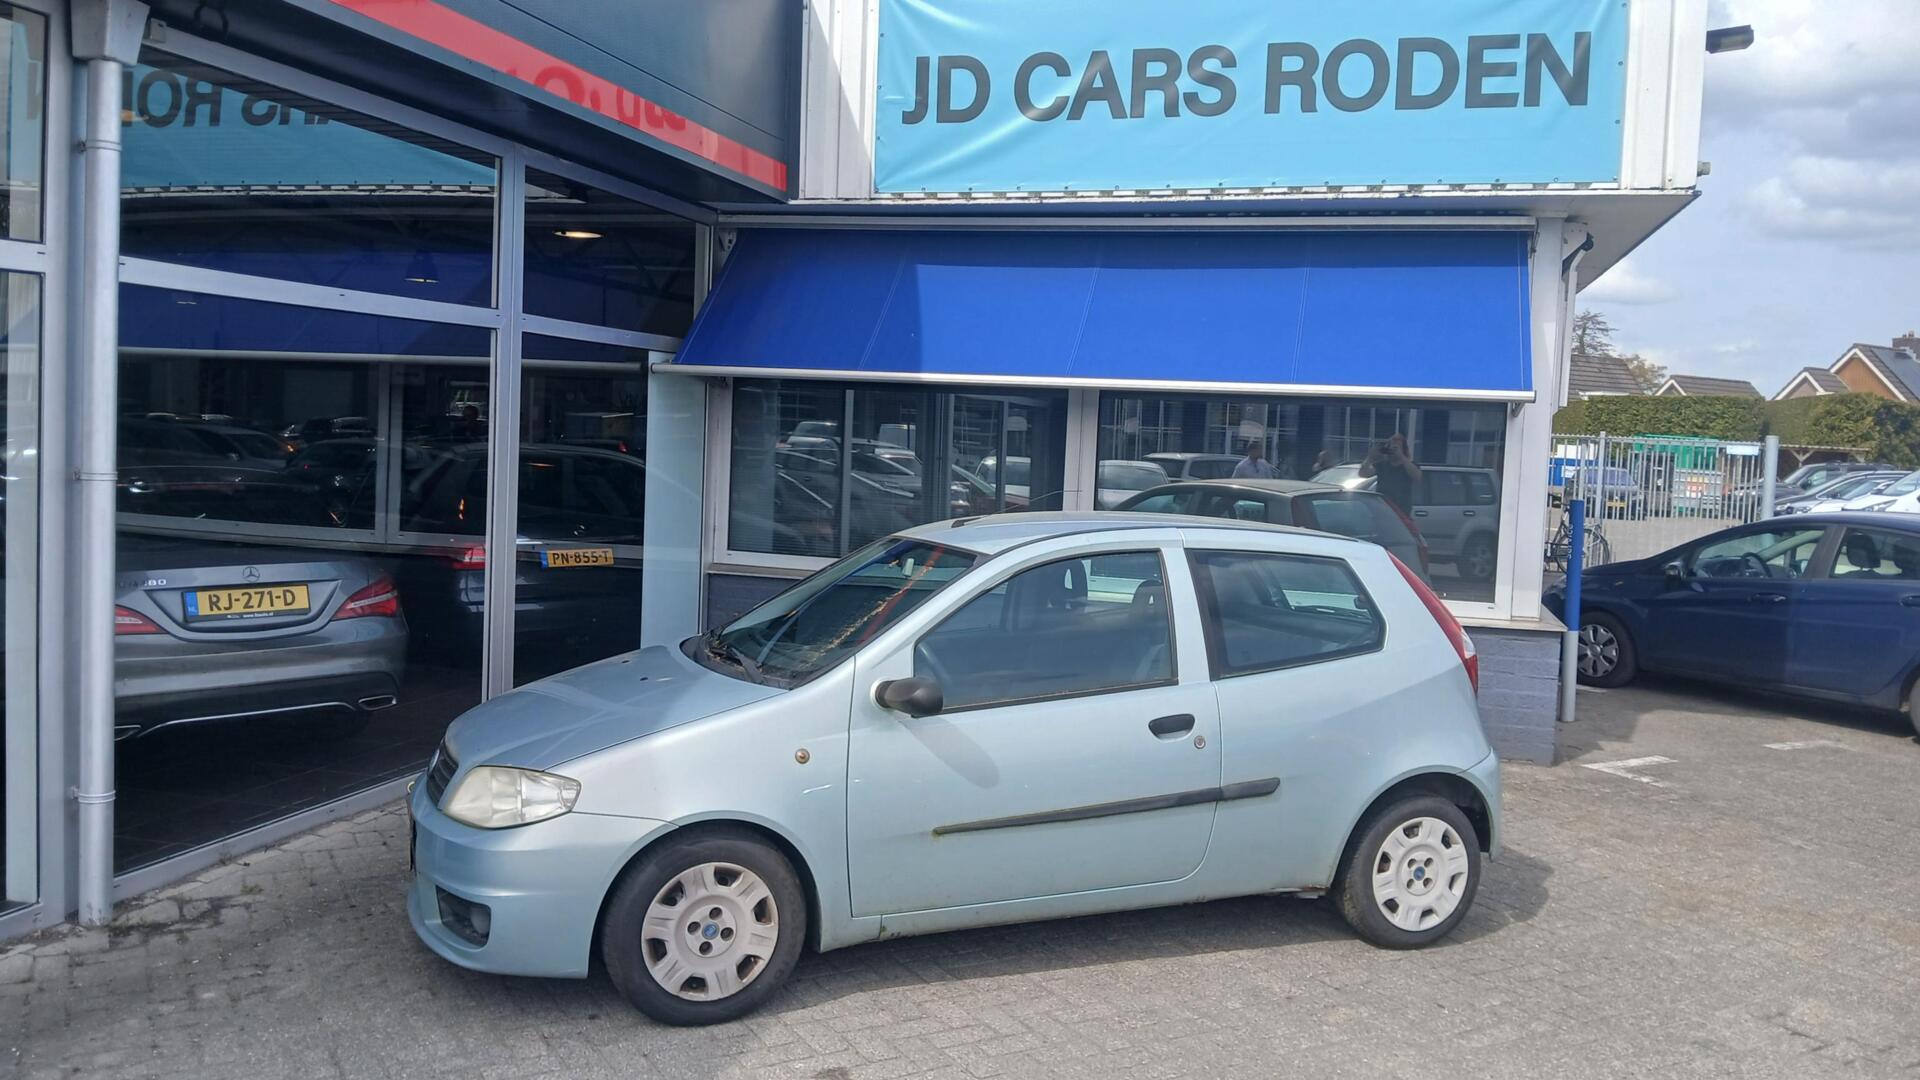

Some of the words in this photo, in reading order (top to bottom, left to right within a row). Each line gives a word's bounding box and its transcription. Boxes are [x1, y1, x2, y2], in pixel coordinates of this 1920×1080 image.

[902, 55, 991, 125] JD
[1014, 44, 1237, 122] CARS
[1264, 31, 1592, 114] RODEN
[551, 550, 609, 565] PN-855-T
[208, 589, 296, 612] RJ-271-D
